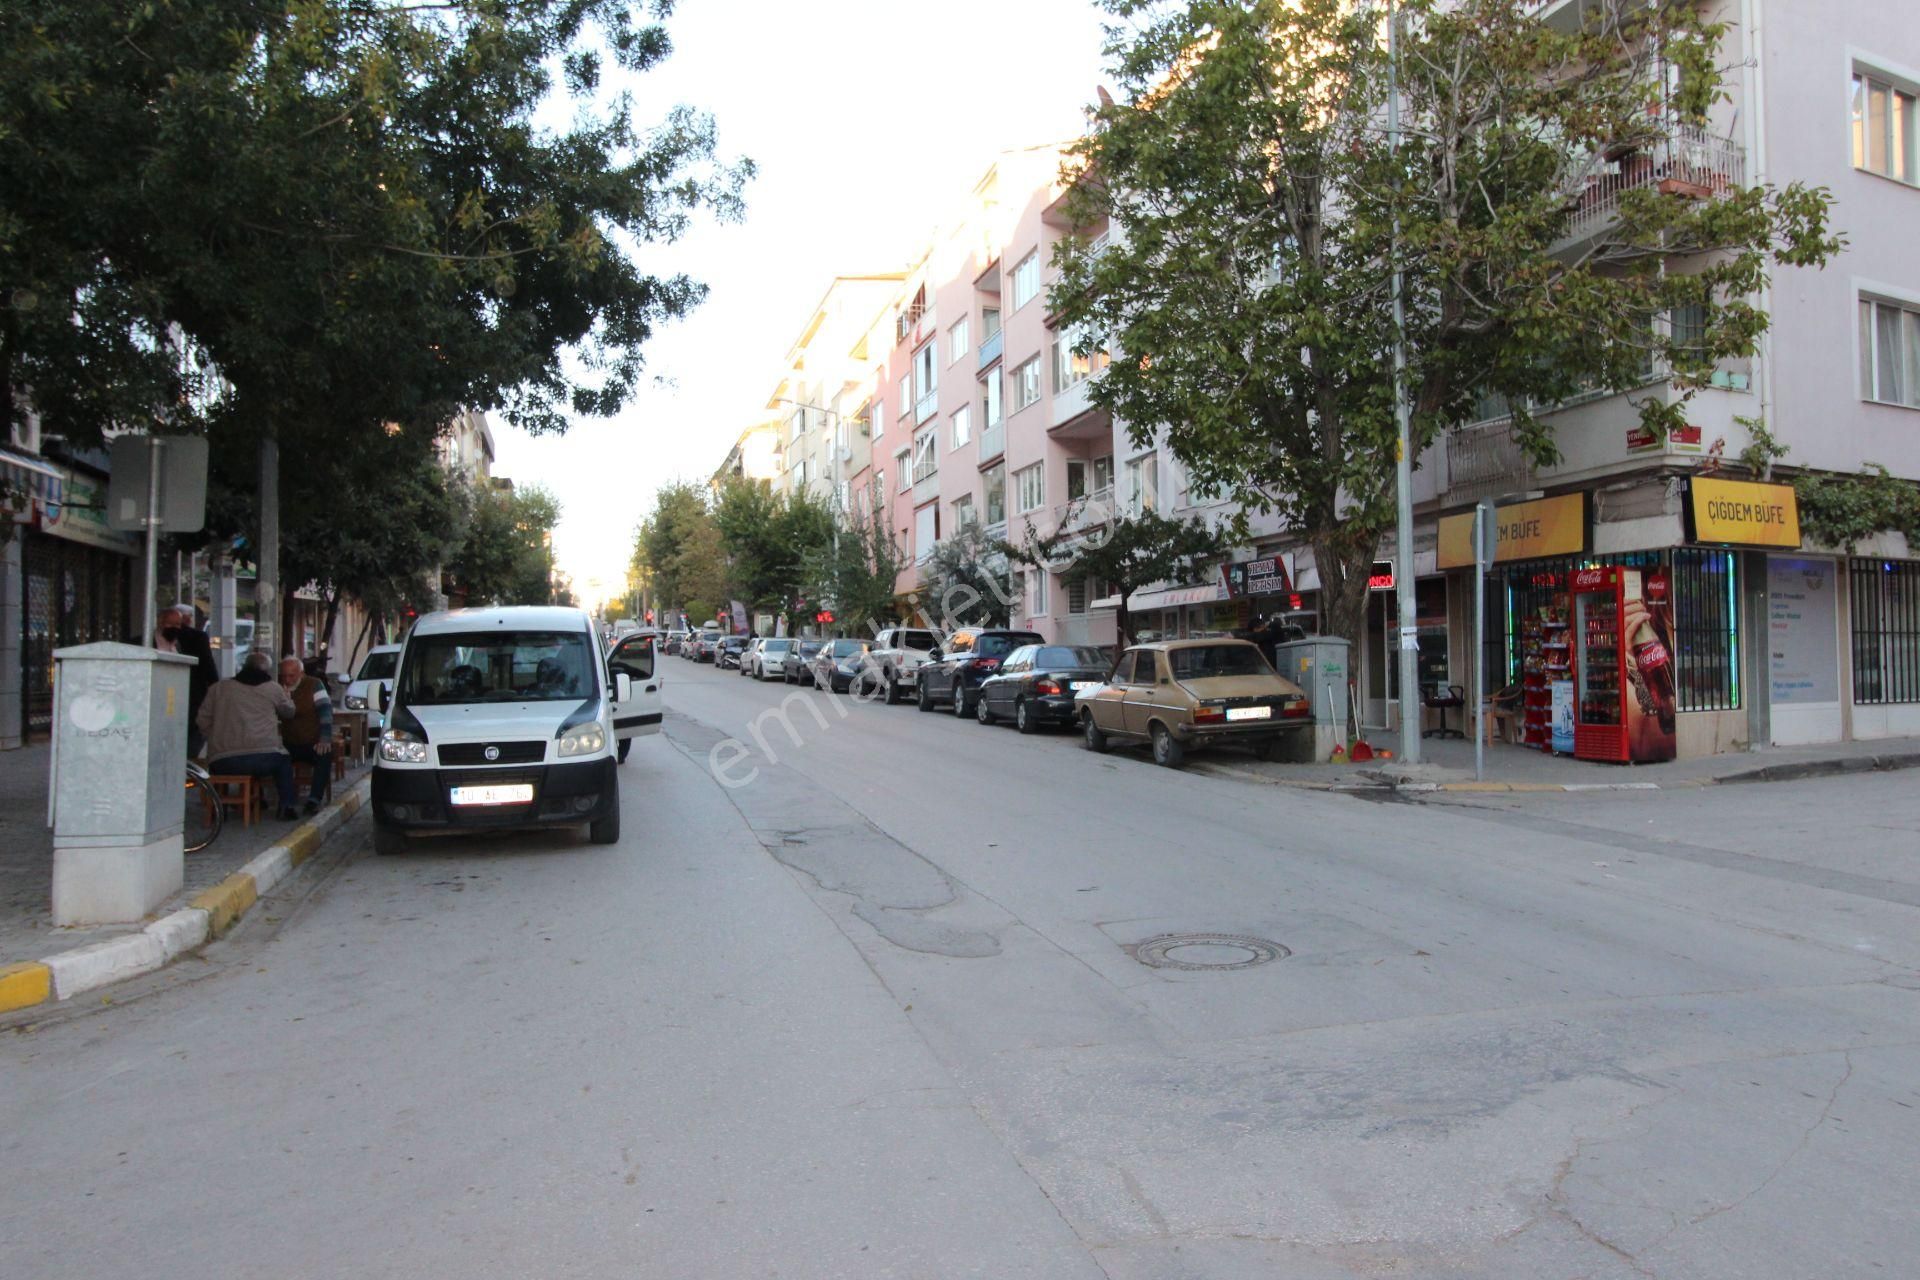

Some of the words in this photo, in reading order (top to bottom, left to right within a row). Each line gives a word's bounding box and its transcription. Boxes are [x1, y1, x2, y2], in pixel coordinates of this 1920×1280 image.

[1707, 496, 1753, 525] ÇİĞDEM
[1754, 500, 1785, 524] BÜFE
[1511, 517, 1541, 540] BÜFE
[1247, 559, 1275, 576] YILMAZ
[1576, 570, 1602, 585] Coca-Cola
